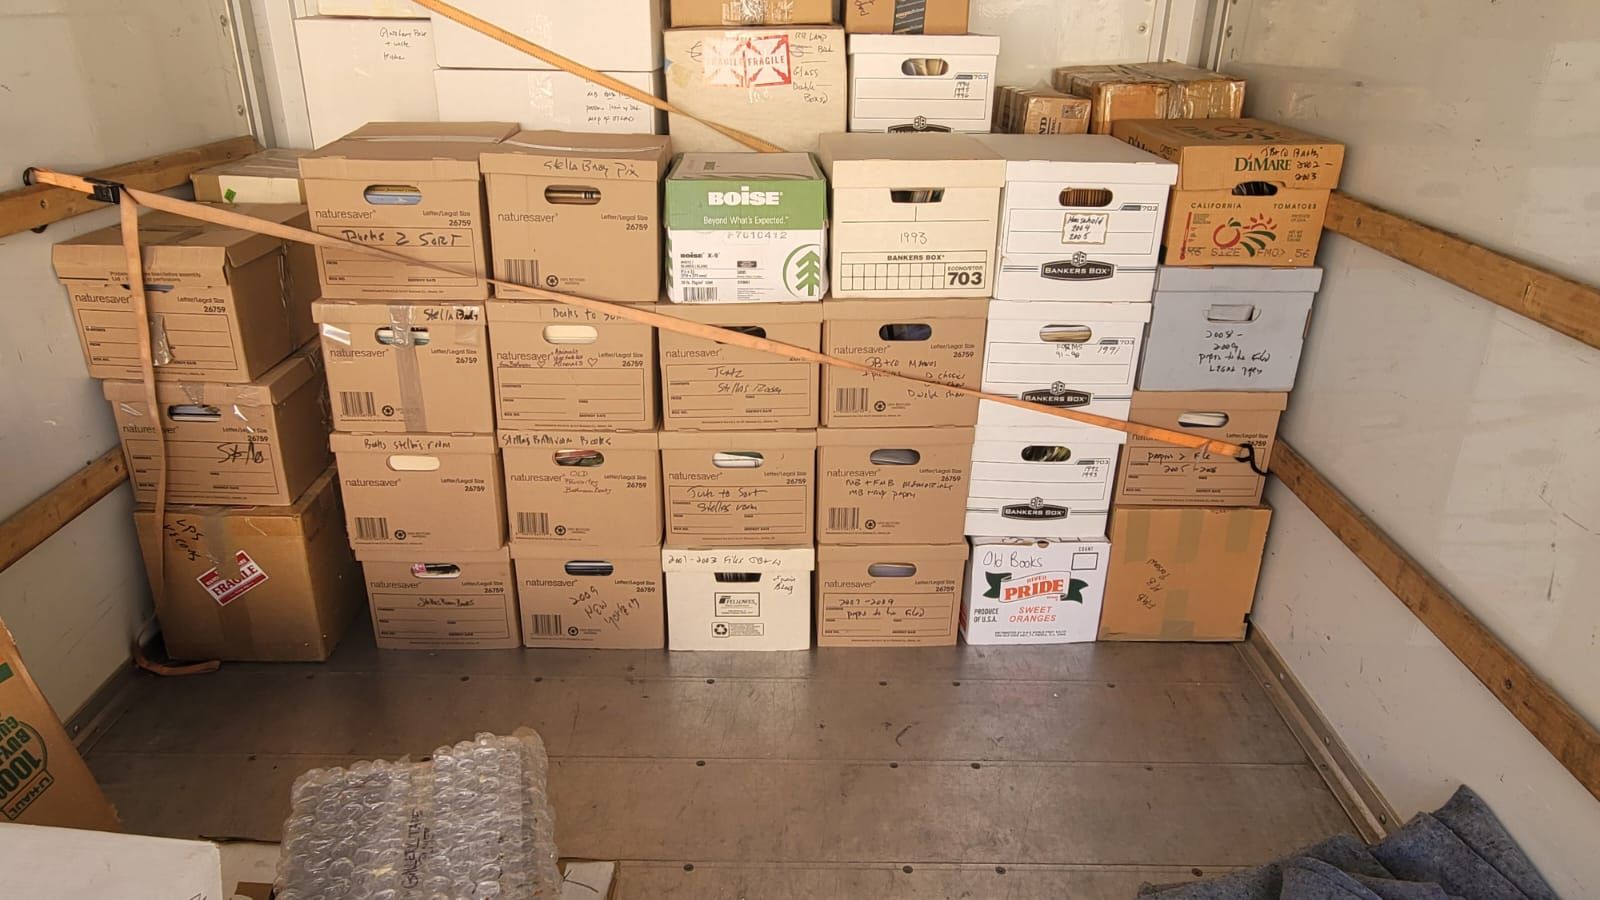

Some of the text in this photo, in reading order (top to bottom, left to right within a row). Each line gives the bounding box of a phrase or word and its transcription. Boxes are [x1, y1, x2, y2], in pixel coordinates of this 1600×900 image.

[748, 55, 785, 66] FRAGILE
[708, 185, 780, 206] BOISE
[315, 208, 373, 219] naturesaver
[498, 212, 556, 223] naturesaver
[703, 216, 786, 225] Beyond What's Expected.
[626, 223, 648, 231] 26759
[900, 231, 928, 245] 1993
[1211, 248, 1241, 257] SIZE
[1045, 267, 1111, 275] BANKERS BOX
[947, 271, 982, 286] 703
[75, 293, 130, 304] naturesaver
[203, 305, 226, 313] 26759
[329, 348, 387, 358] naturesaver
[665, 348, 722, 358] naturesaver
[834, 344, 888, 354] naturesaver
[456, 356, 477, 364] 26759
[497, 351, 551, 361] naturesaver
[622, 360, 643, 368] 26759
[1025, 394, 1087, 402] BANKERS BOX
[669, 471, 720, 481] naturesaver
[827, 468, 880, 477] naturesaver
[510, 473, 563, 482] naturesaver
[786, 477, 807, 485] 26759
[346, 478, 398, 487] naturesaver
[1005, 508, 1044, 516] BANKERS
[983, 551, 1043, 568] Old Books
[370, 580, 419, 589] naturesaver
[525, 578, 575, 587] naturesaver
[824, 580, 873, 588] naturesaver
[1005, 579, 1064, 601] PRIDE
[974, 607, 999, 615] PRODUCE
[1019, 606, 1052, 614] SWEET
[1009, 614, 1057, 623] ORANGES
[8, 777, 51, 815] U-HAUL
